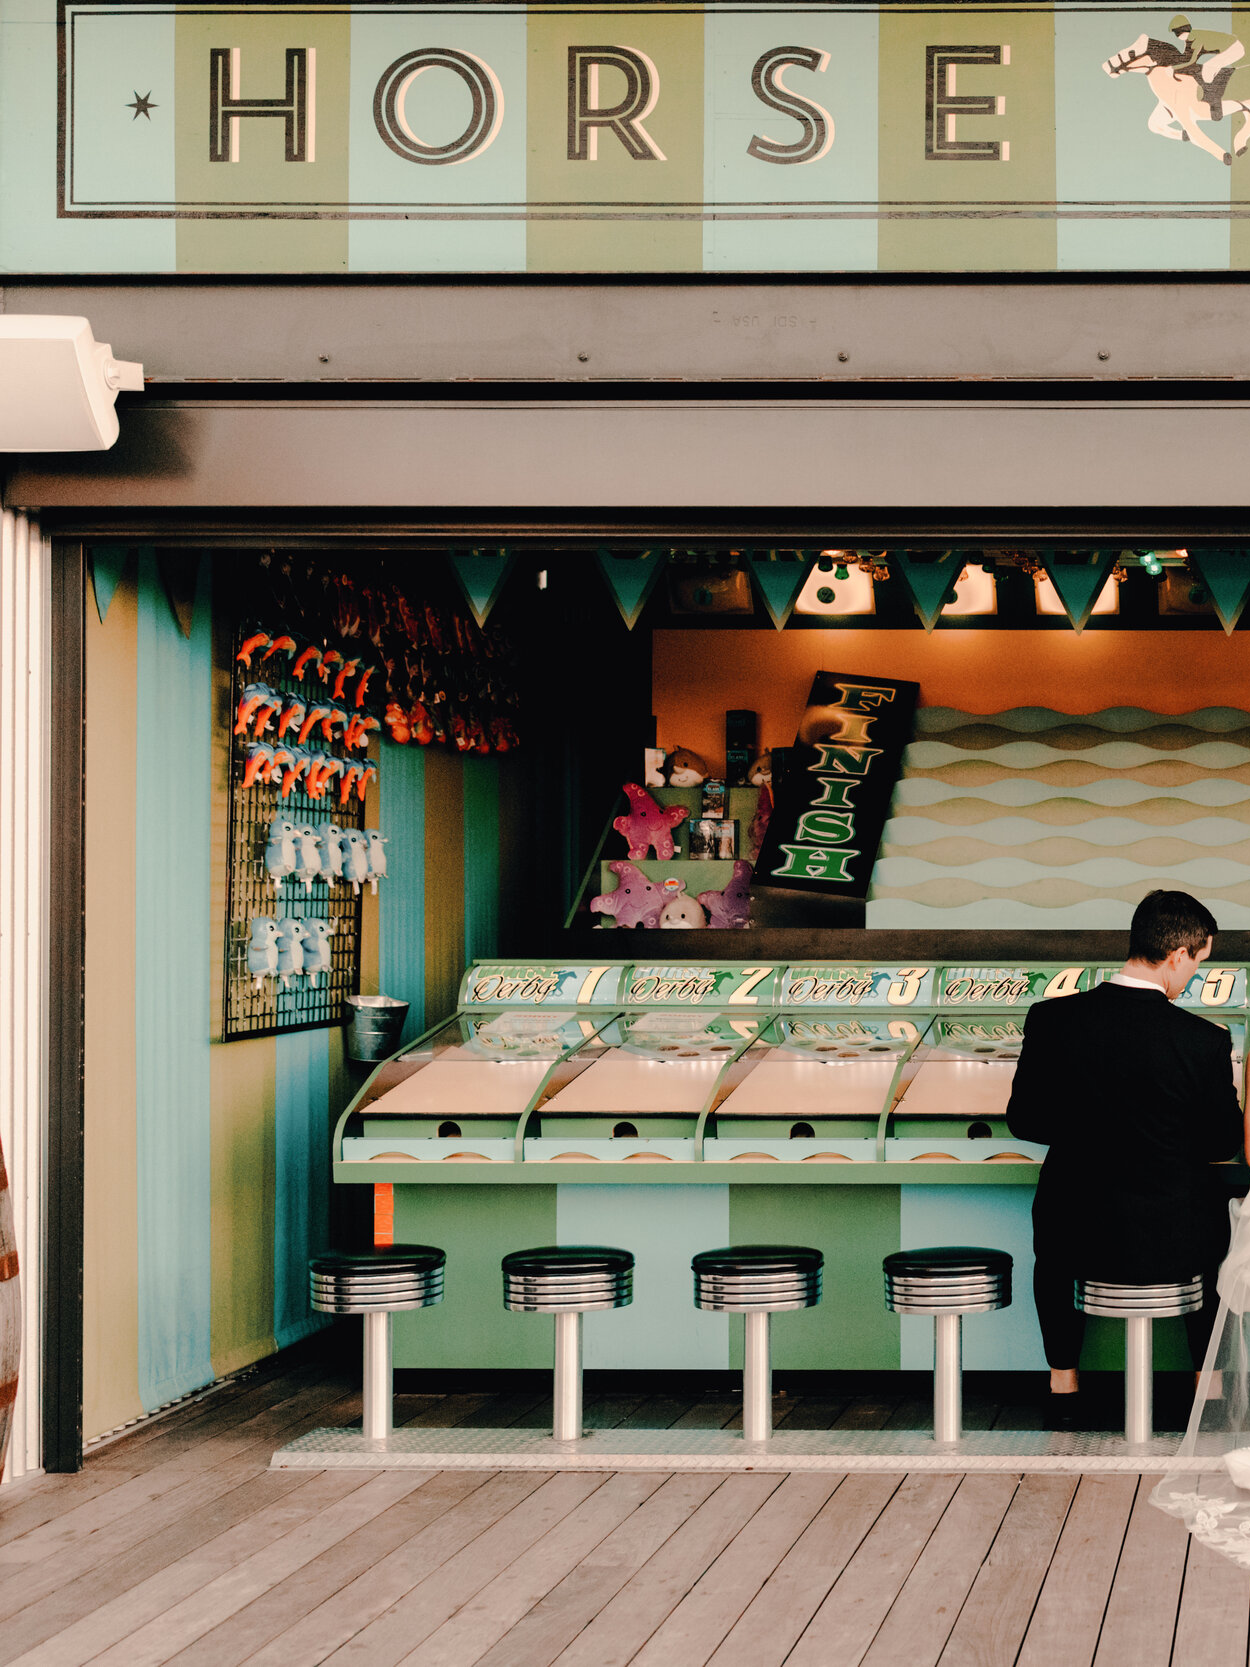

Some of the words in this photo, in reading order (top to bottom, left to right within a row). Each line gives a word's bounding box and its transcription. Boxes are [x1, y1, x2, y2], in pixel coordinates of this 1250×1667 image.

[209, 44, 1012, 165] HORSE
[770, 683, 898, 883] FINISH
[473, 975, 560, 1004] Derby
[576, 966, 611, 1005] 1
[628, 975, 716, 1004] Derby
[728, 966, 774, 1005] 2
[787, 976, 874, 1005] Derby
[886, 967, 928, 1006] 3
[944, 976, 1029, 1005] Derby
[1043, 968, 1086, 998] 4
[1199, 968, 1241, 1007] 5
